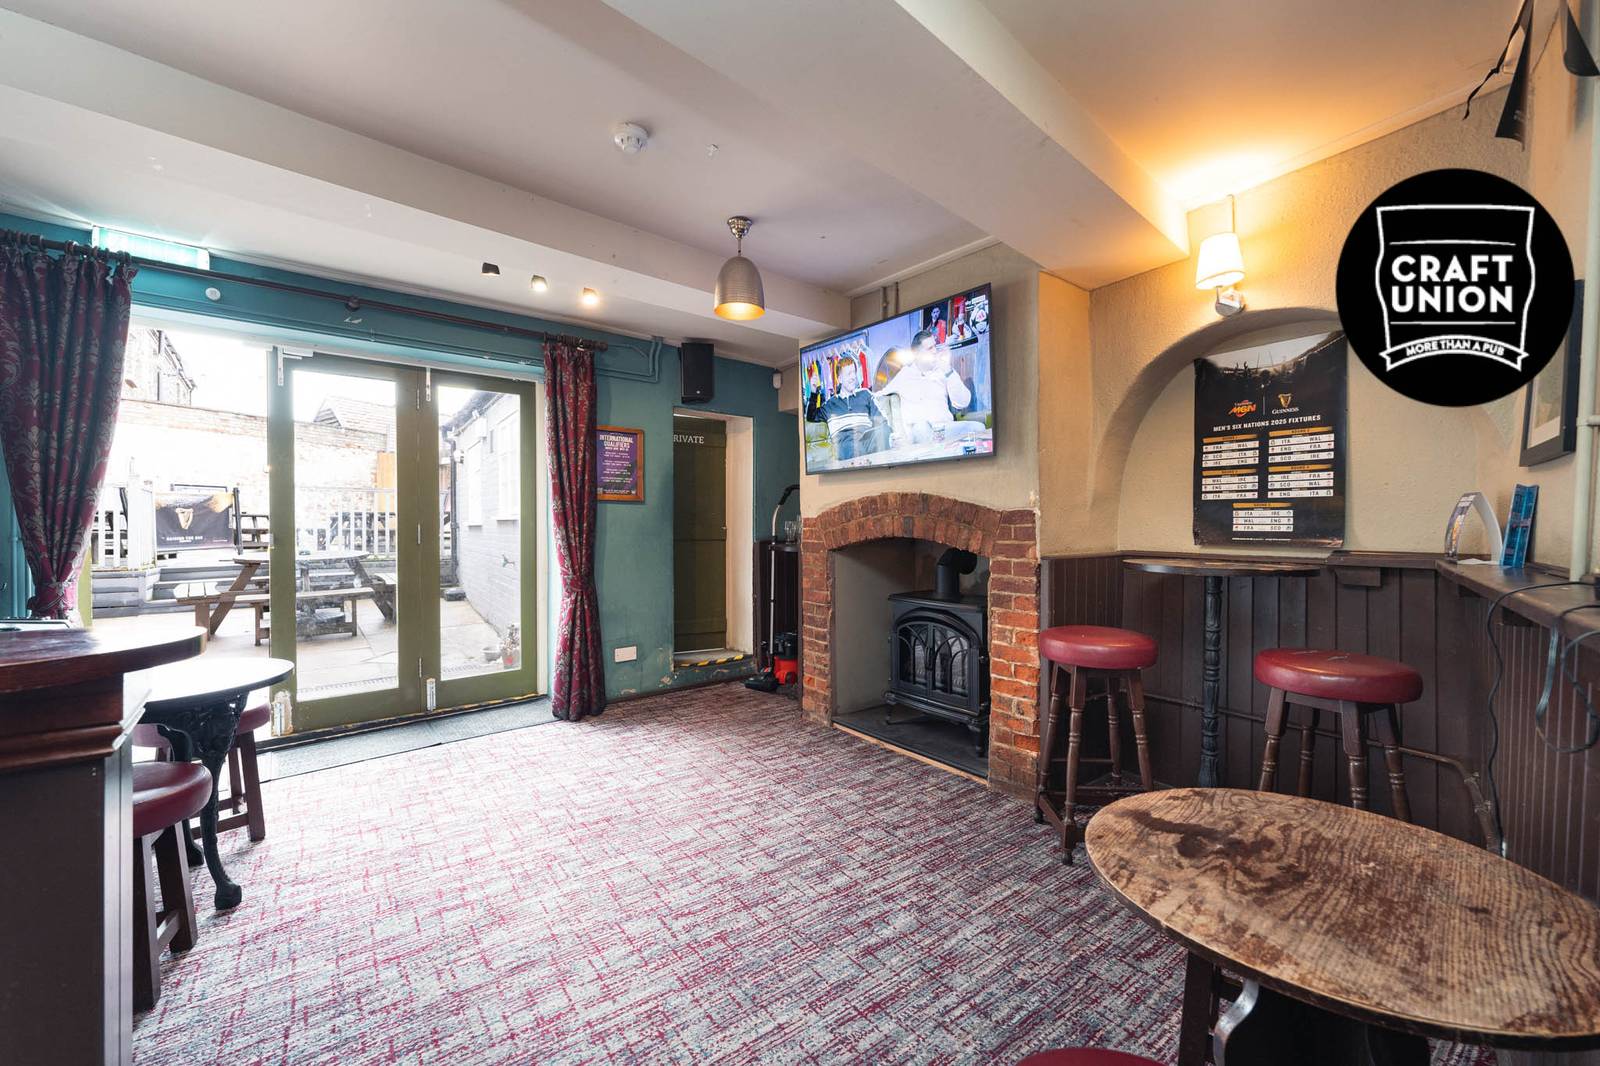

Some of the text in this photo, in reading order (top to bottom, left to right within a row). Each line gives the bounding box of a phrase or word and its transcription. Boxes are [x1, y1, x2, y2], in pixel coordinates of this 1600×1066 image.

[1272, 406, 1300, 414] GUINNESS
[1244, 420, 1269, 429] NATIONS
[1288, 414, 1321, 424] FIXTURES
[673, 434, 705, 444] RIVATE
